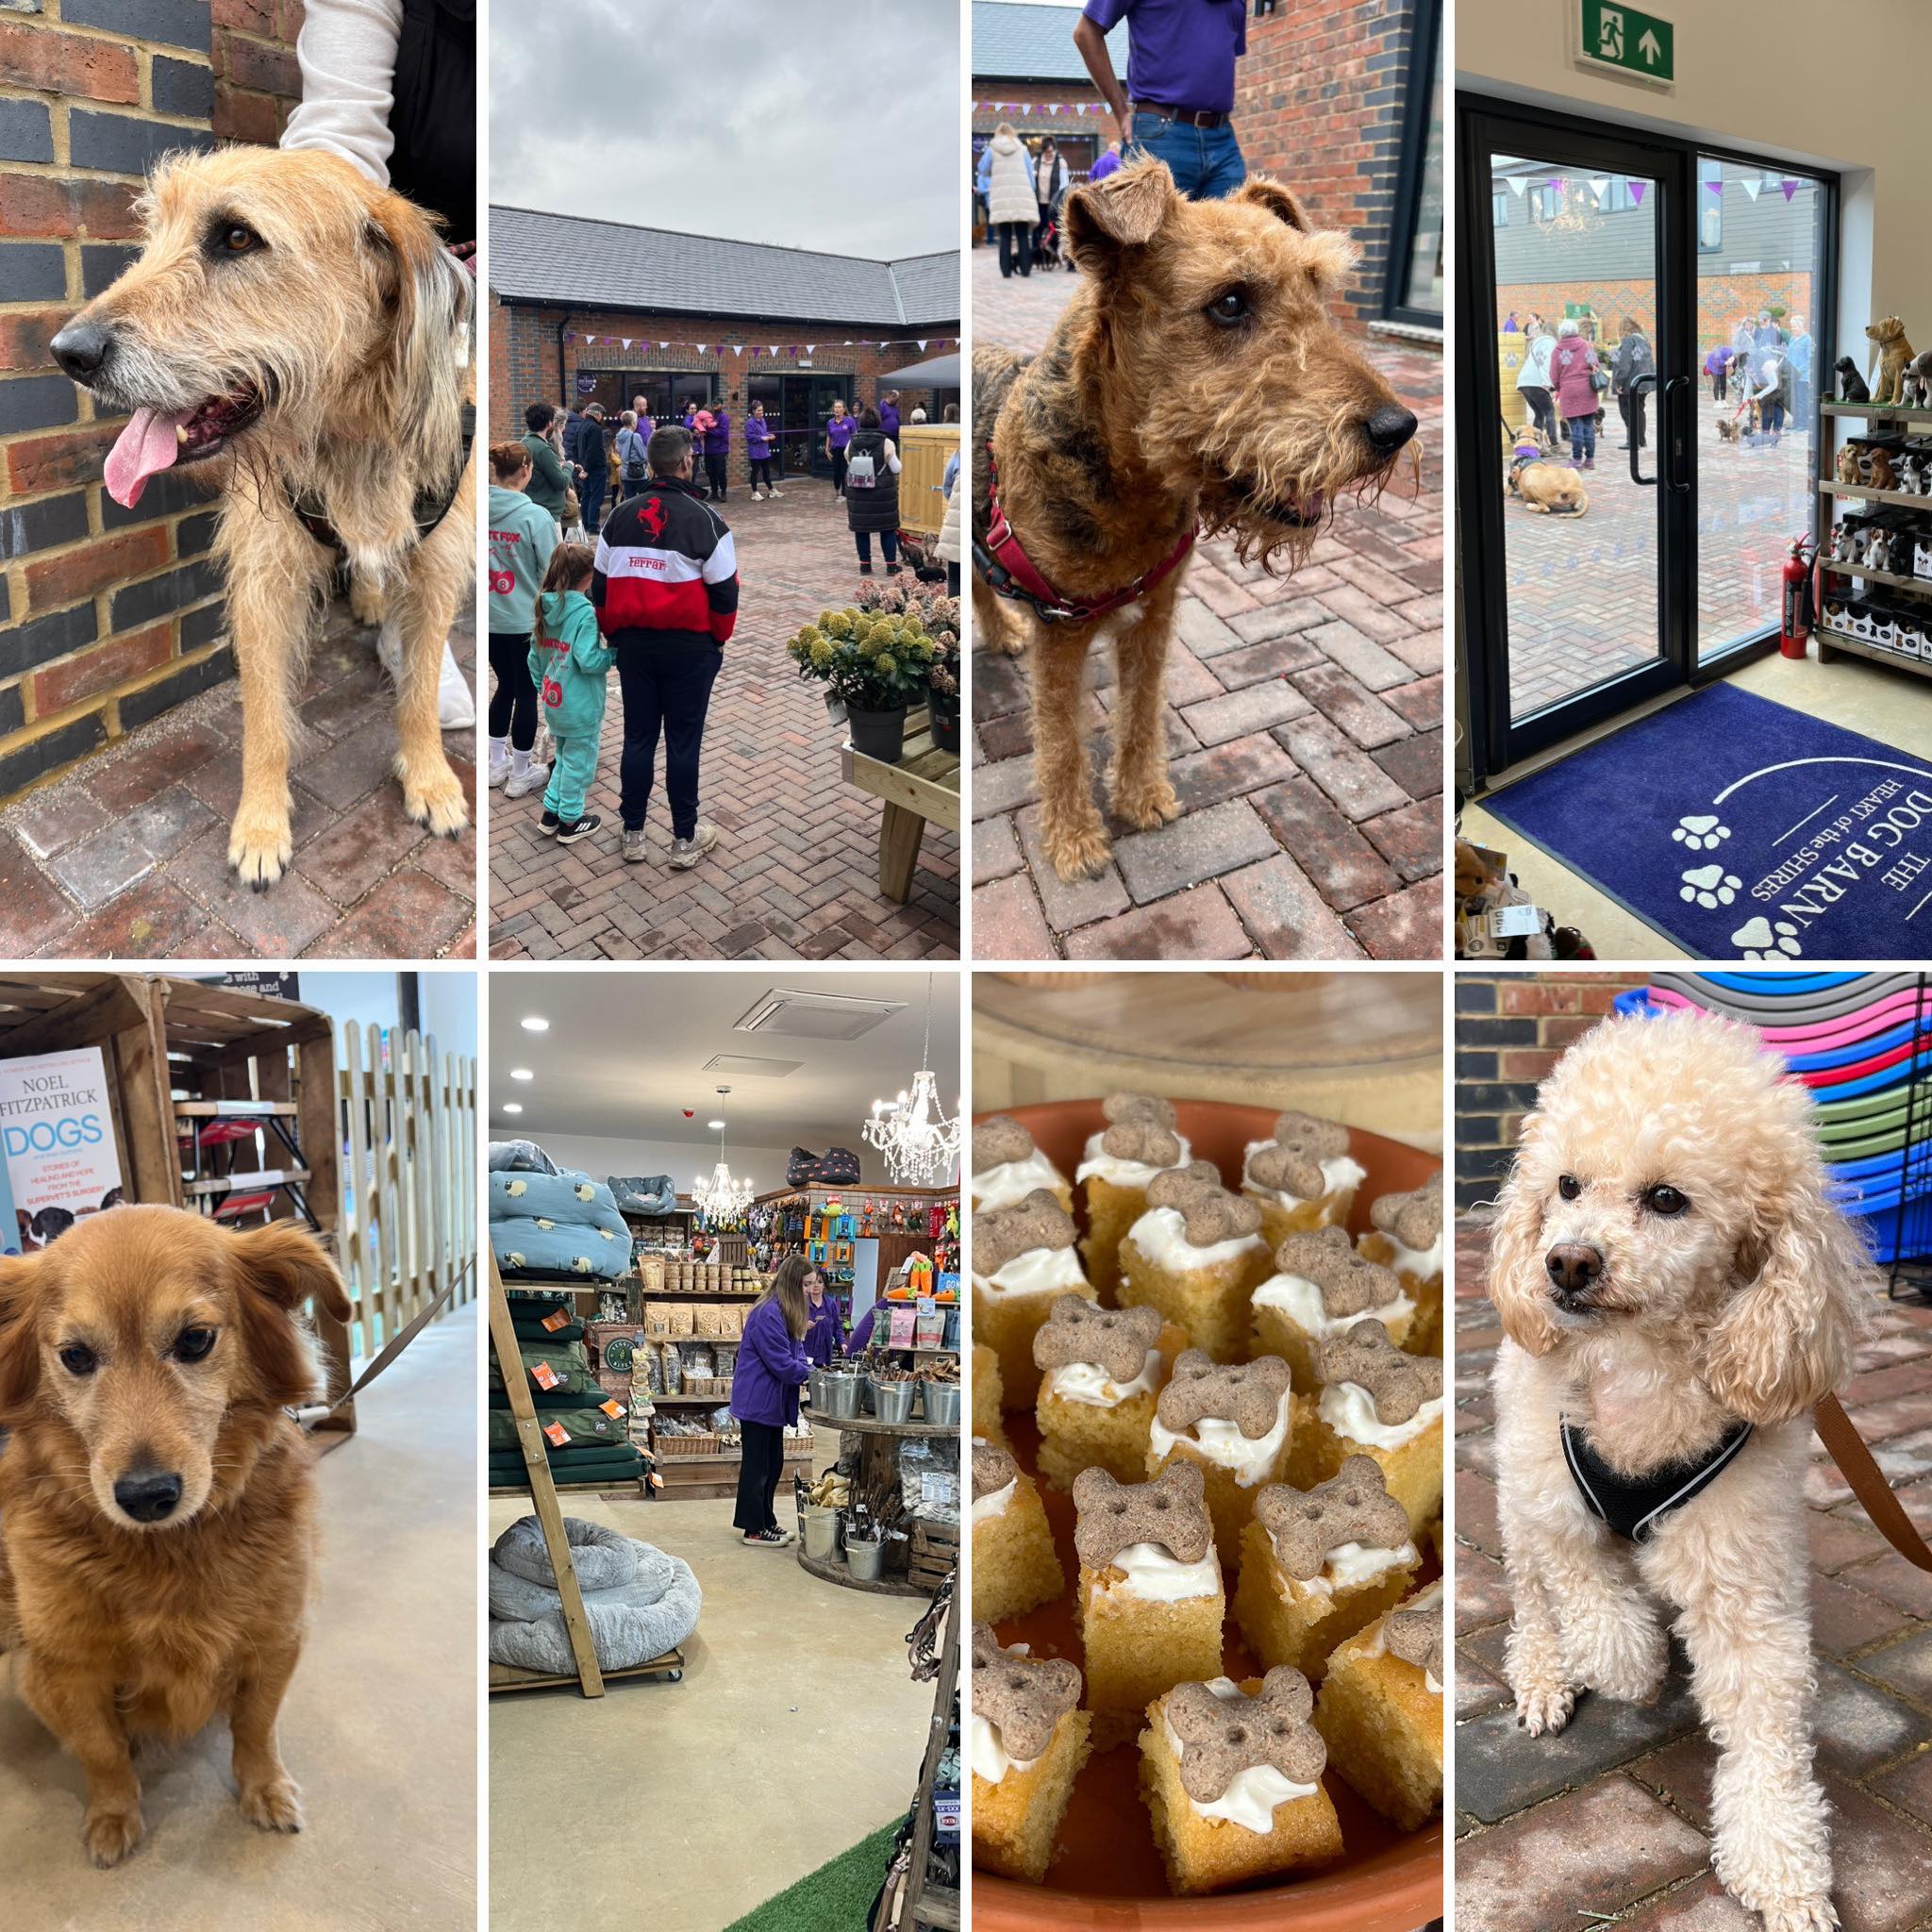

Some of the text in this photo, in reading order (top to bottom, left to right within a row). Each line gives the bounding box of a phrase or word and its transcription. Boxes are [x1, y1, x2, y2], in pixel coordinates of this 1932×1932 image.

[1751, 778, 1905, 902] HEART of the SHIRES
[1779, 790, 1932, 928] DOG BARN
[1880, 851, 1932, 891] THE
[258, 981, 280, 993] and
[23, 1075, 69, 1094] NOEL
[0, 1089, 98, 1117] FITZPATRICK
[4, 1114, 103, 1157] DOGS
[30, 1168, 94, 1185] HEALING AND HOPE
[42, 1161, 70, 1173] STORIES
[26, 1185, 105, 1206] SUPERVET'S SURGERY
[48, 1179, 81, 1191] FROM THE
